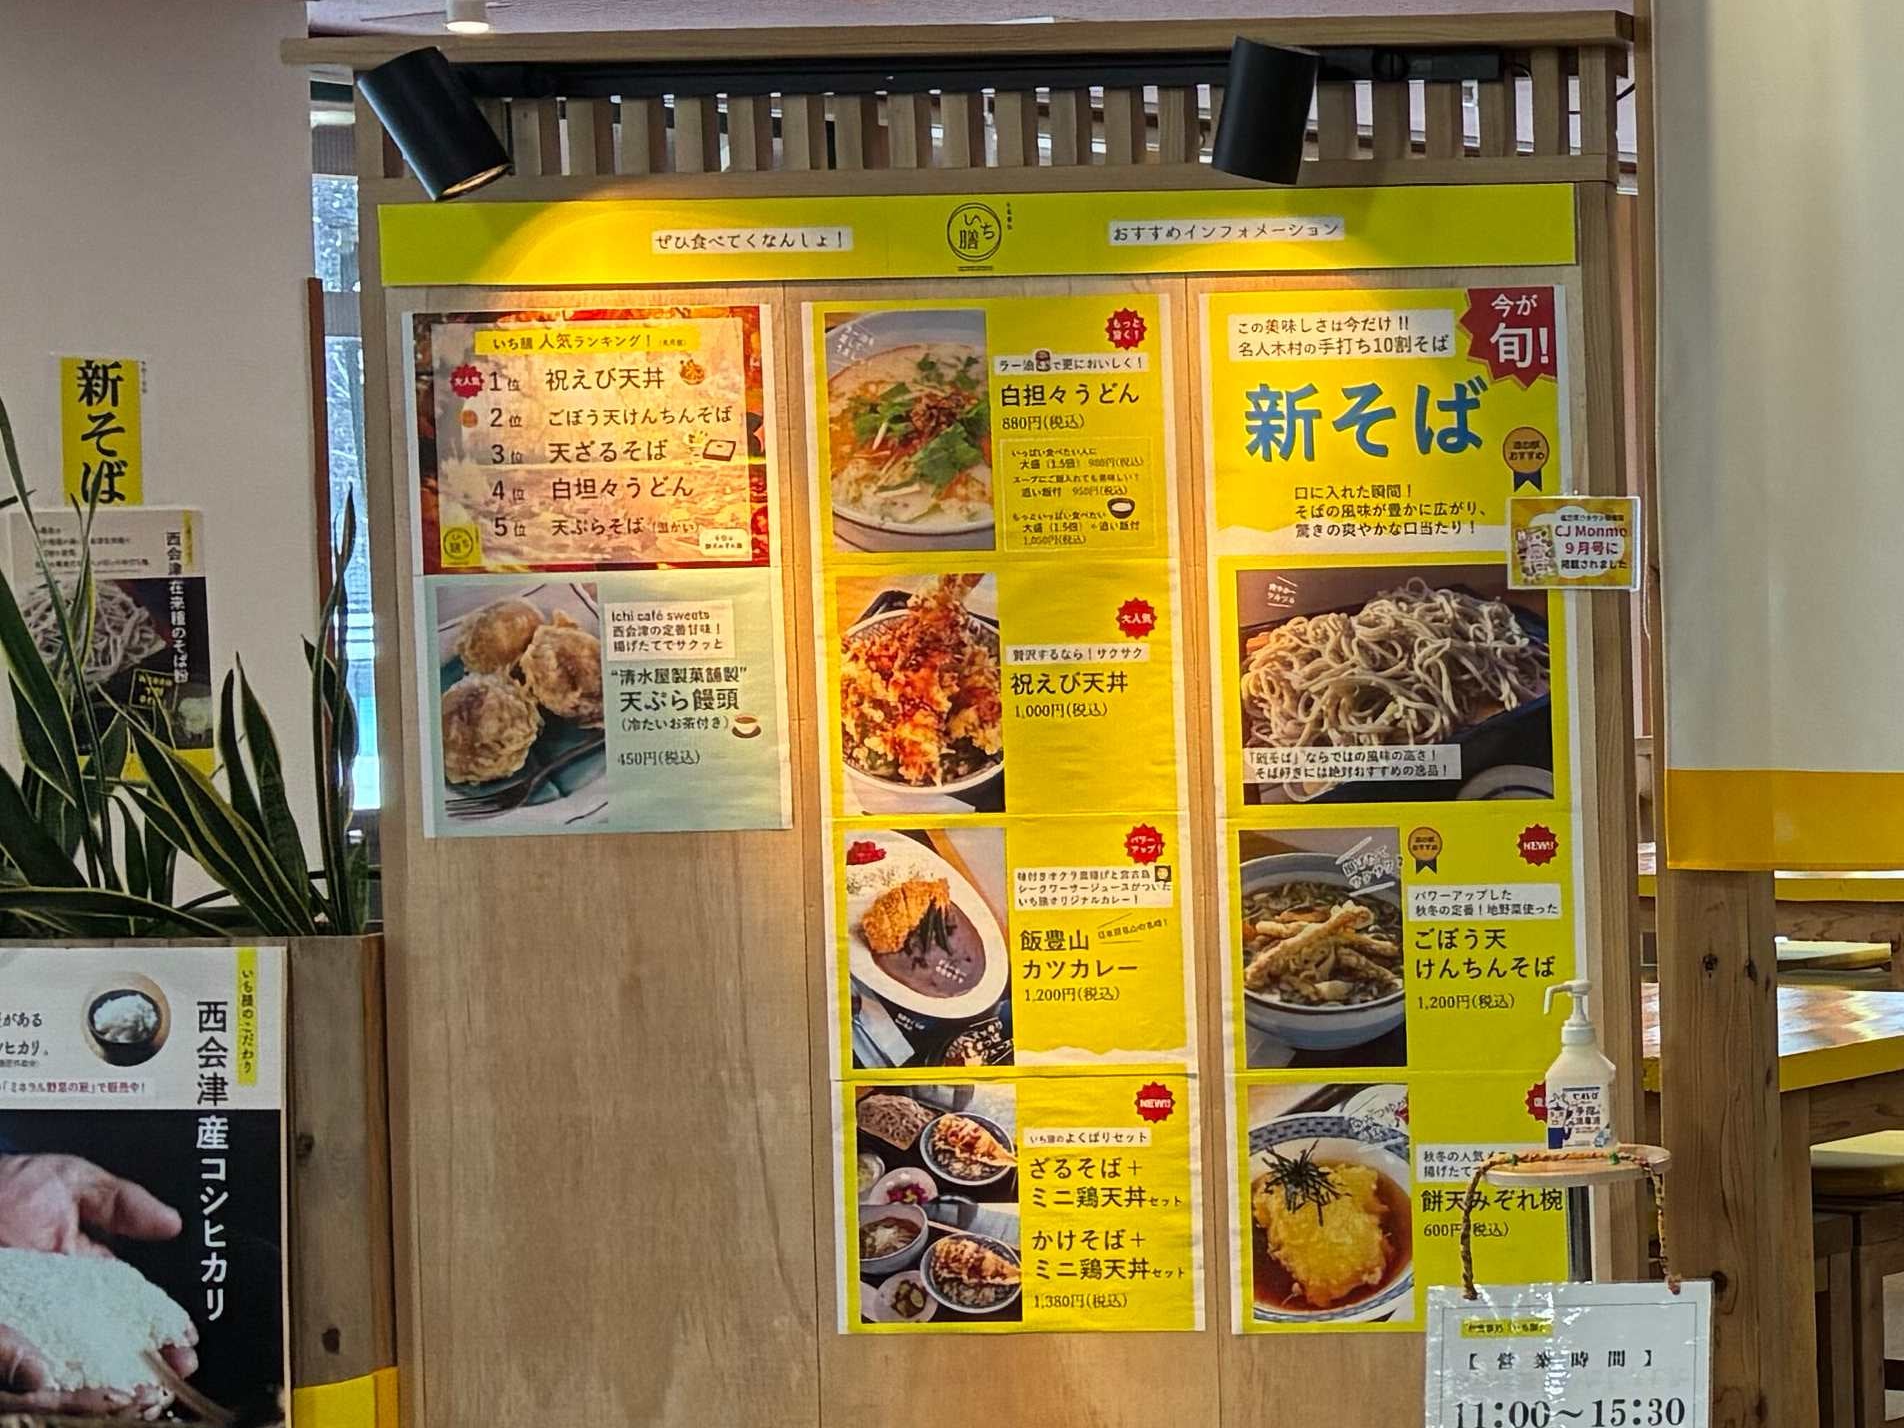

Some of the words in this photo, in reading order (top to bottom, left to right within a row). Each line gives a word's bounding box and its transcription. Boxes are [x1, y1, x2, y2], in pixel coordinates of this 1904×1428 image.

[1113, 221, 1339, 242] おすすめインフォメーション
[1491, 294, 1538, 317] 今が
[1237, 334, 1449, 356] 名人木村の手打ち10割そば
[546, 368, 664, 390] 祝えび天丼
[1002, 382, 1139, 407] 白担々うどん
[549, 407, 732, 425] ごぼう天けんちんそば
[1245, 375, 1486, 462] 新そば
[76, 359, 126, 505] 新そば
[549, 440, 668, 463] 天ざるそば
[1295, 502, 1487, 518] そばの風味が豊かに広がり、
[552, 518, 644, 535] 天ぷらそば
[1555, 526, 1570, 536] CJ
[1576, 526, 1628, 536] Monmo
[612, 611, 633, 621] Ichi
[1011, 671, 1128, 695] 祝えび天丼
[620, 688, 739, 712] 天ぷら饅頭
[1415, 889, 1512, 901] パワーアップした
[1020, 929, 1089, 952] 飯豊山
[1415, 929, 1507, 950] ごぼう天
[1023, 959, 1137, 979] カツカレー
[1416, 956, 1555, 980] けんちんそば
[196, 1001, 229, 1320] 西会津産コシヒカリ
[1422, 1188, 1563, 1213] 餅天みぞれ椀
[1424, 1221, 1510, 1237] 600円税込)
